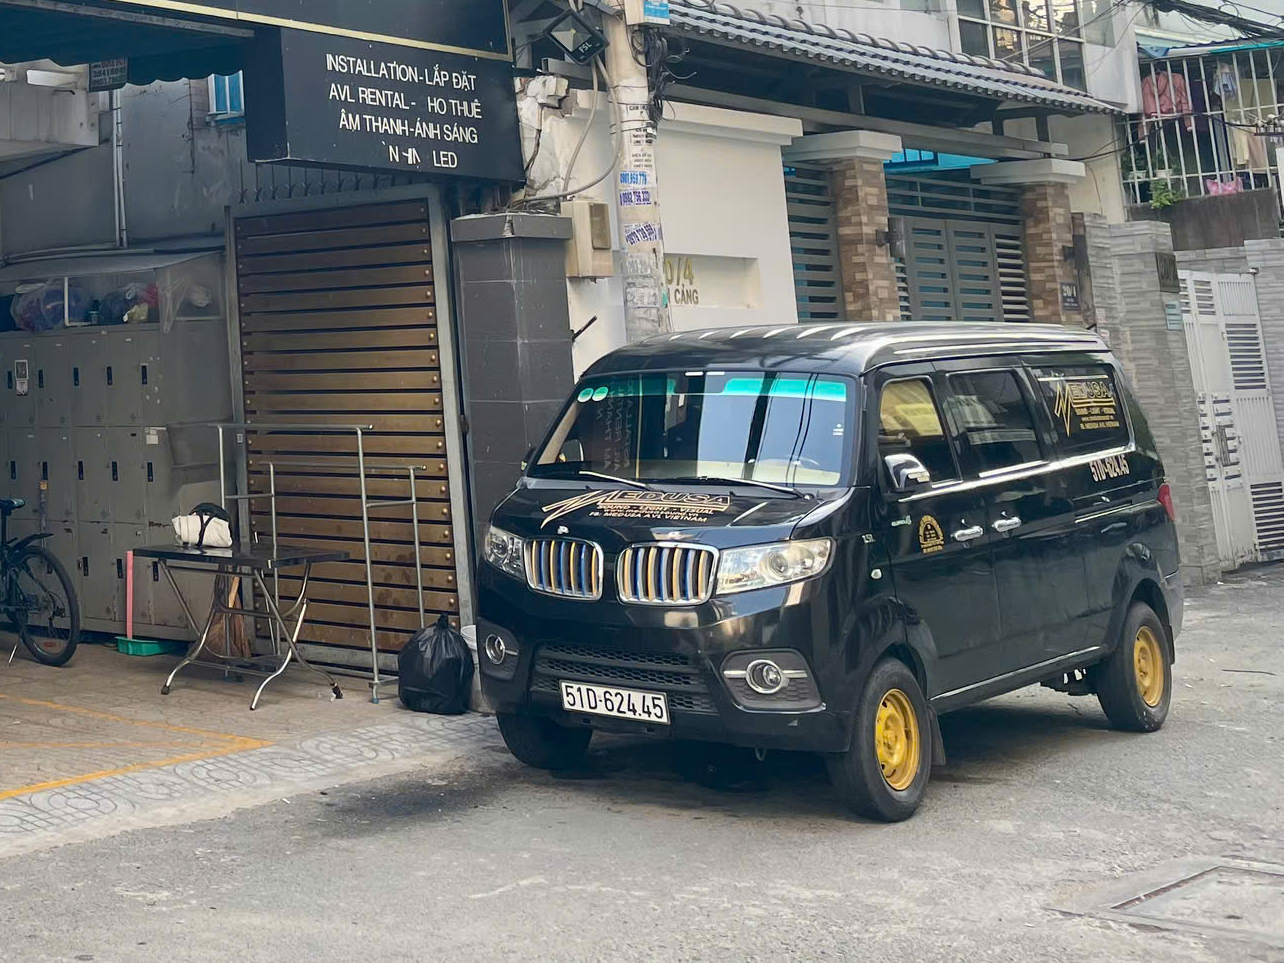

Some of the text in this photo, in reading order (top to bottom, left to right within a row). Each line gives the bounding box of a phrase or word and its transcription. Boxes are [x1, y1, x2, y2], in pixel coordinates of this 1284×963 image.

[329, 83, 356, 102] AVL
[427, 96, 447, 115] HO
[449, 99, 482, 118] THUÊ
[443, 123, 478, 143] SÁNG
[432, 150, 457, 168] LED
[541, 489, 732, 529] MEDUSA
[565, 685, 664, 719] 51D-624.45
